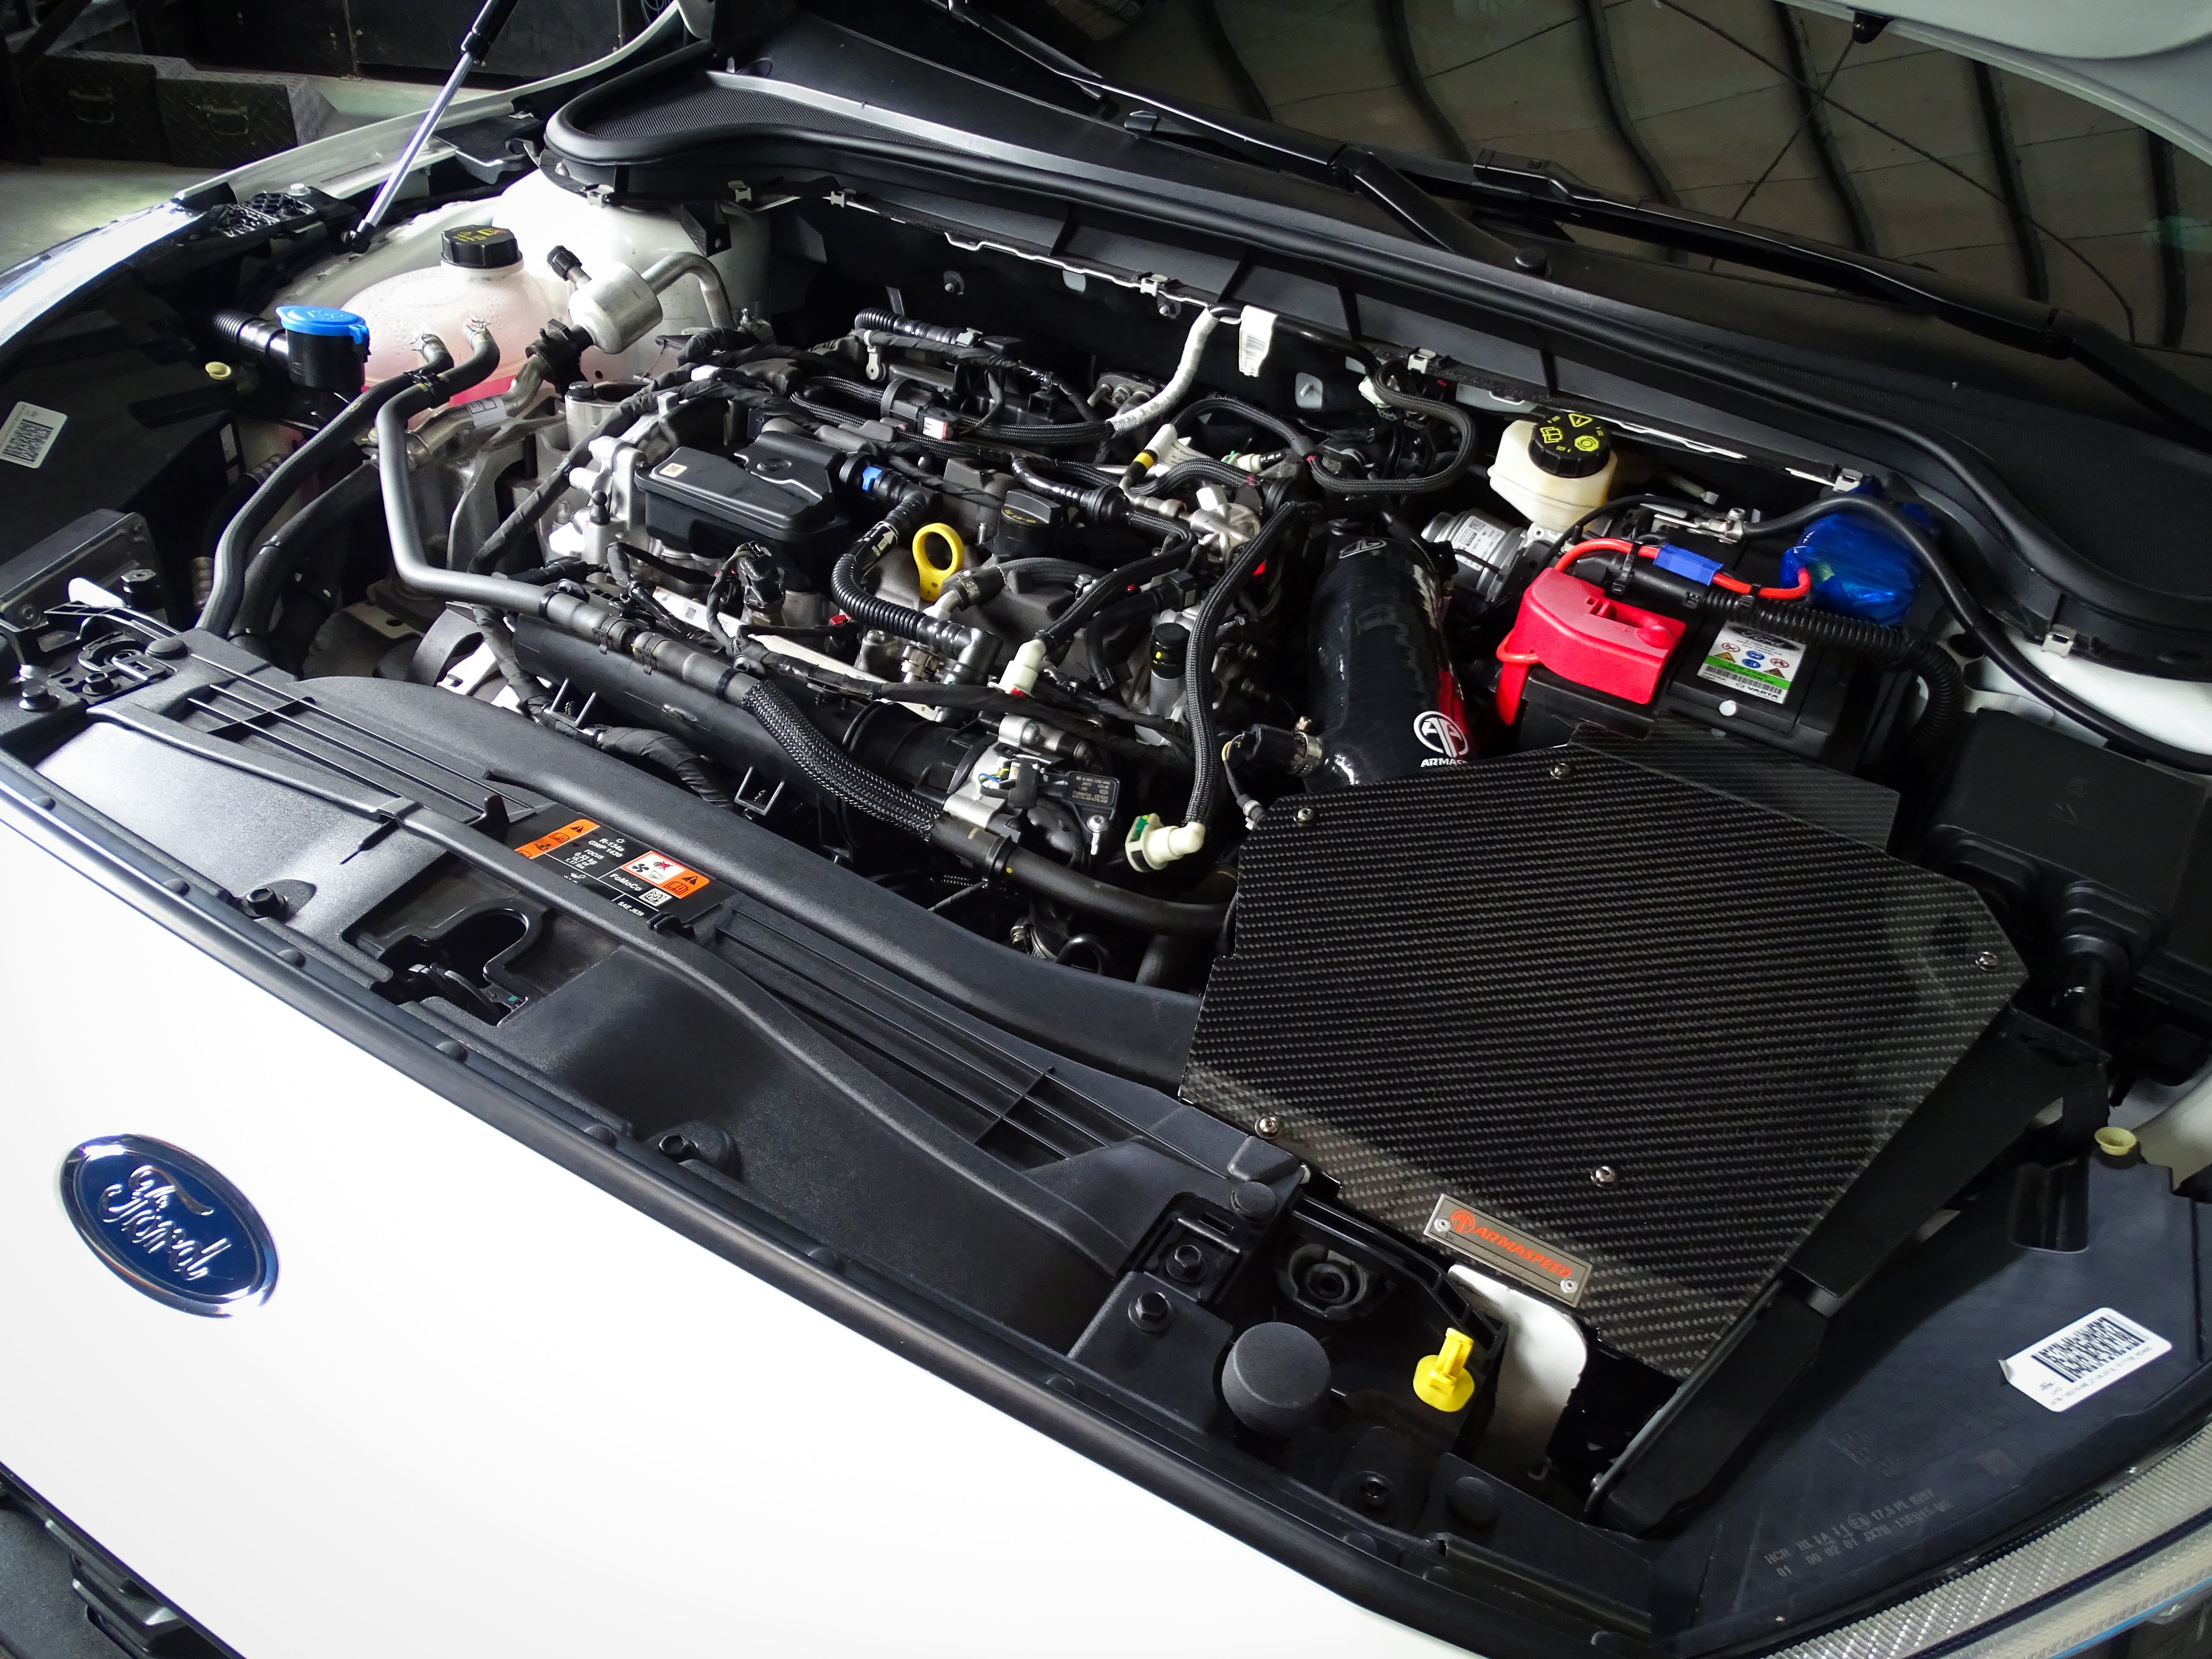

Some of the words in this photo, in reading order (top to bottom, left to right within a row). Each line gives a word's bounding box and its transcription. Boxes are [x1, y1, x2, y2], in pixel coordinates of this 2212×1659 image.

[1741, 631, 1784, 646] Ford
[1748, 686, 1778, 699] VARTA
[588, 840, 606, 849] GWP
[606, 848, 623, 857] 1430
[599, 838, 624, 852] R-134a
[574, 852, 590, 860] 0.53
[584, 849, 604, 859] FOCUS
[609, 873, 642, 891] FoMoCo
[617, 901, 632, 910] SAE
[629, 908, 644, 916] J639
[98, 1165, 232, 1281] Ford
[1474, 1226, 1572, 1278] ARMASPEED
